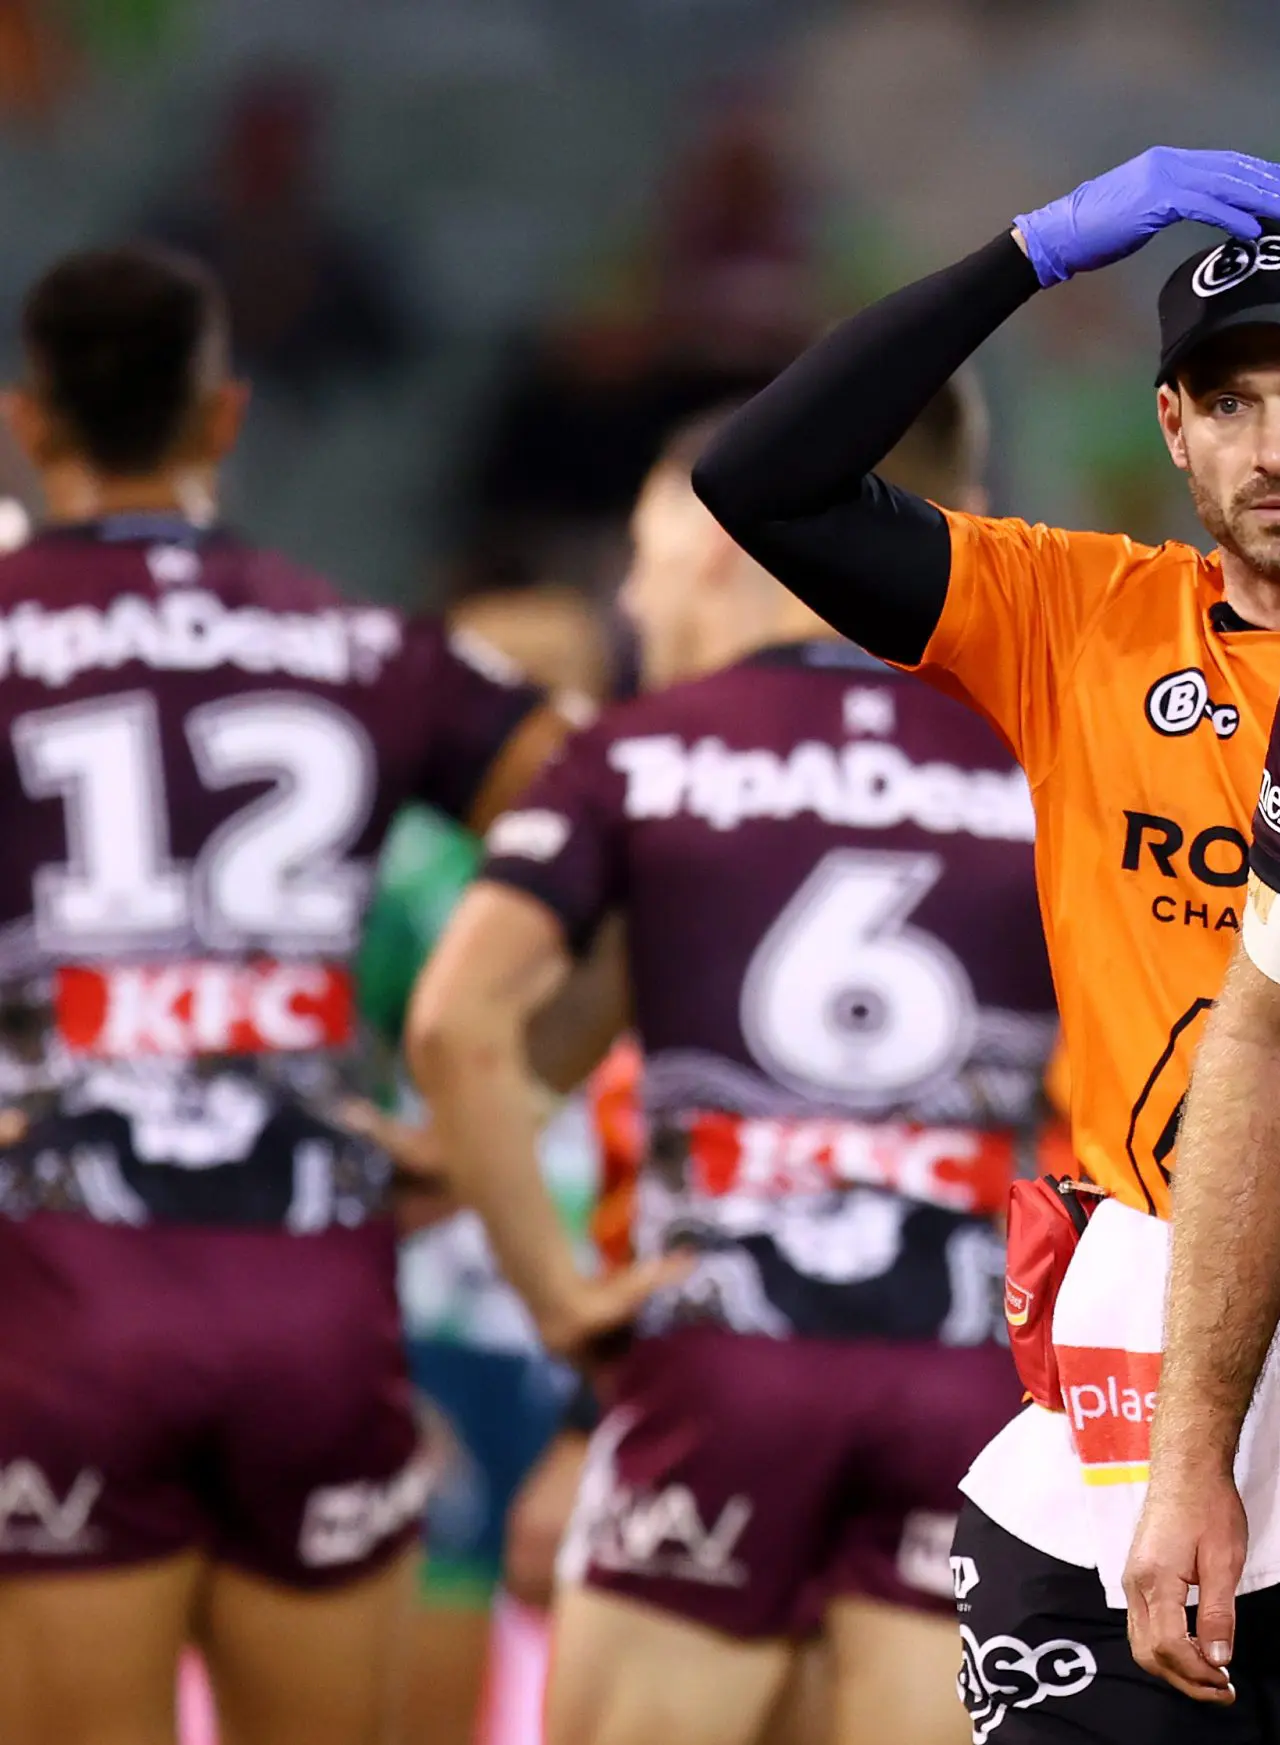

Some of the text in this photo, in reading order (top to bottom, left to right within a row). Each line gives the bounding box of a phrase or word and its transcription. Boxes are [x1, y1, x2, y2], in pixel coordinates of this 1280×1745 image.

[10, 688, 378, 953] 12
[104, 960, 330, 1053] KFC
[740, 846, 978, 1105] 6
